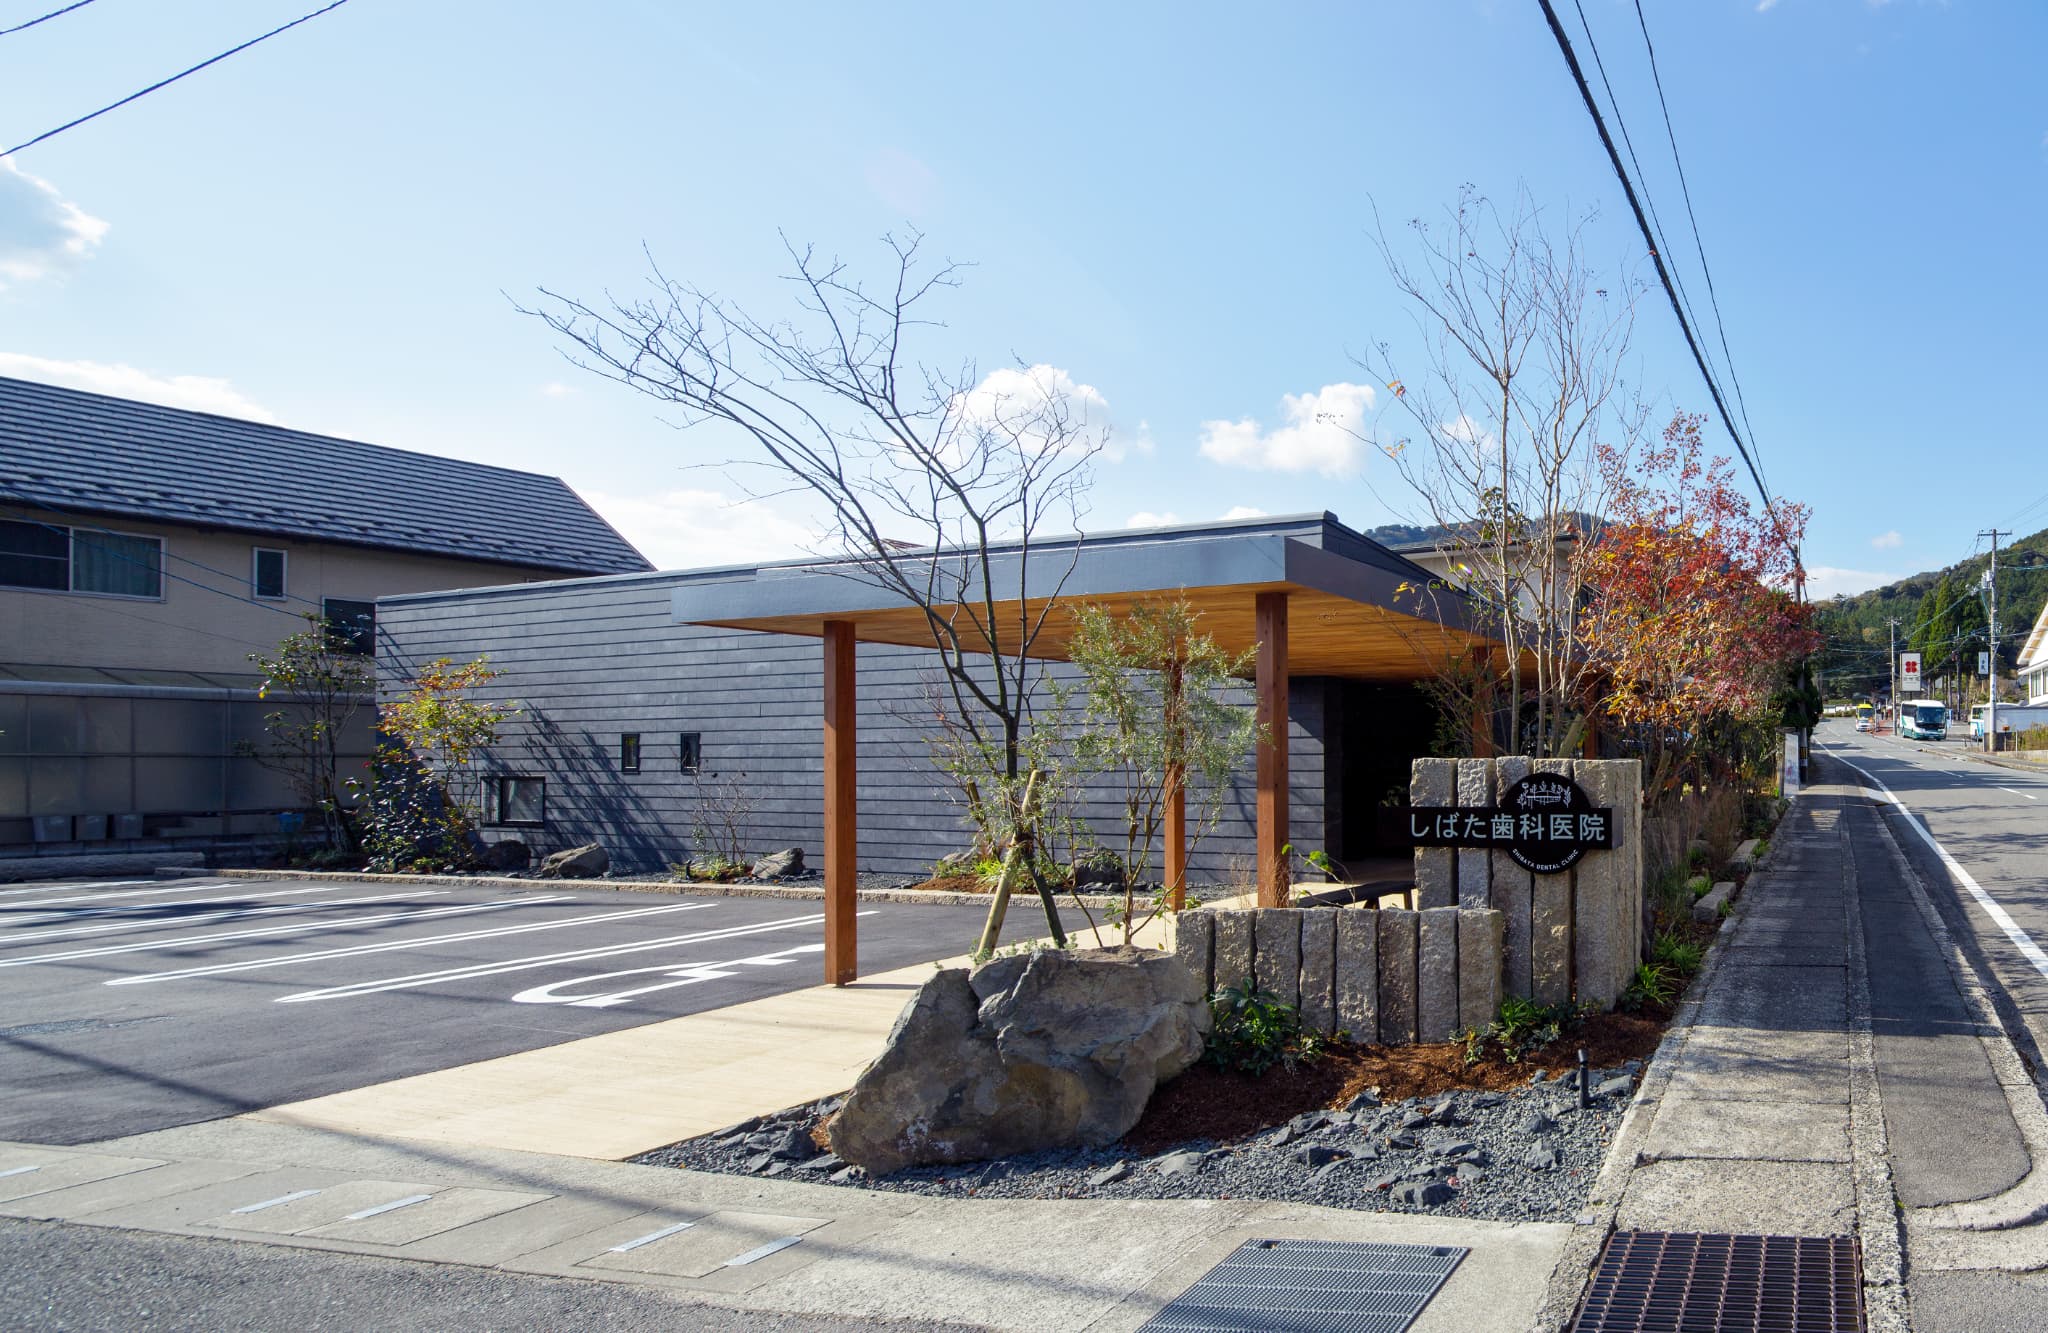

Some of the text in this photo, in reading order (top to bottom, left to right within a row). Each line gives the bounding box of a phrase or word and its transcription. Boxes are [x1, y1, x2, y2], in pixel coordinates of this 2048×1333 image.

[1410, 812, 1605, 841] しばた歯科医院
[1512, 848, 1579, 871] SHIBATA DENTAL CLINIC
